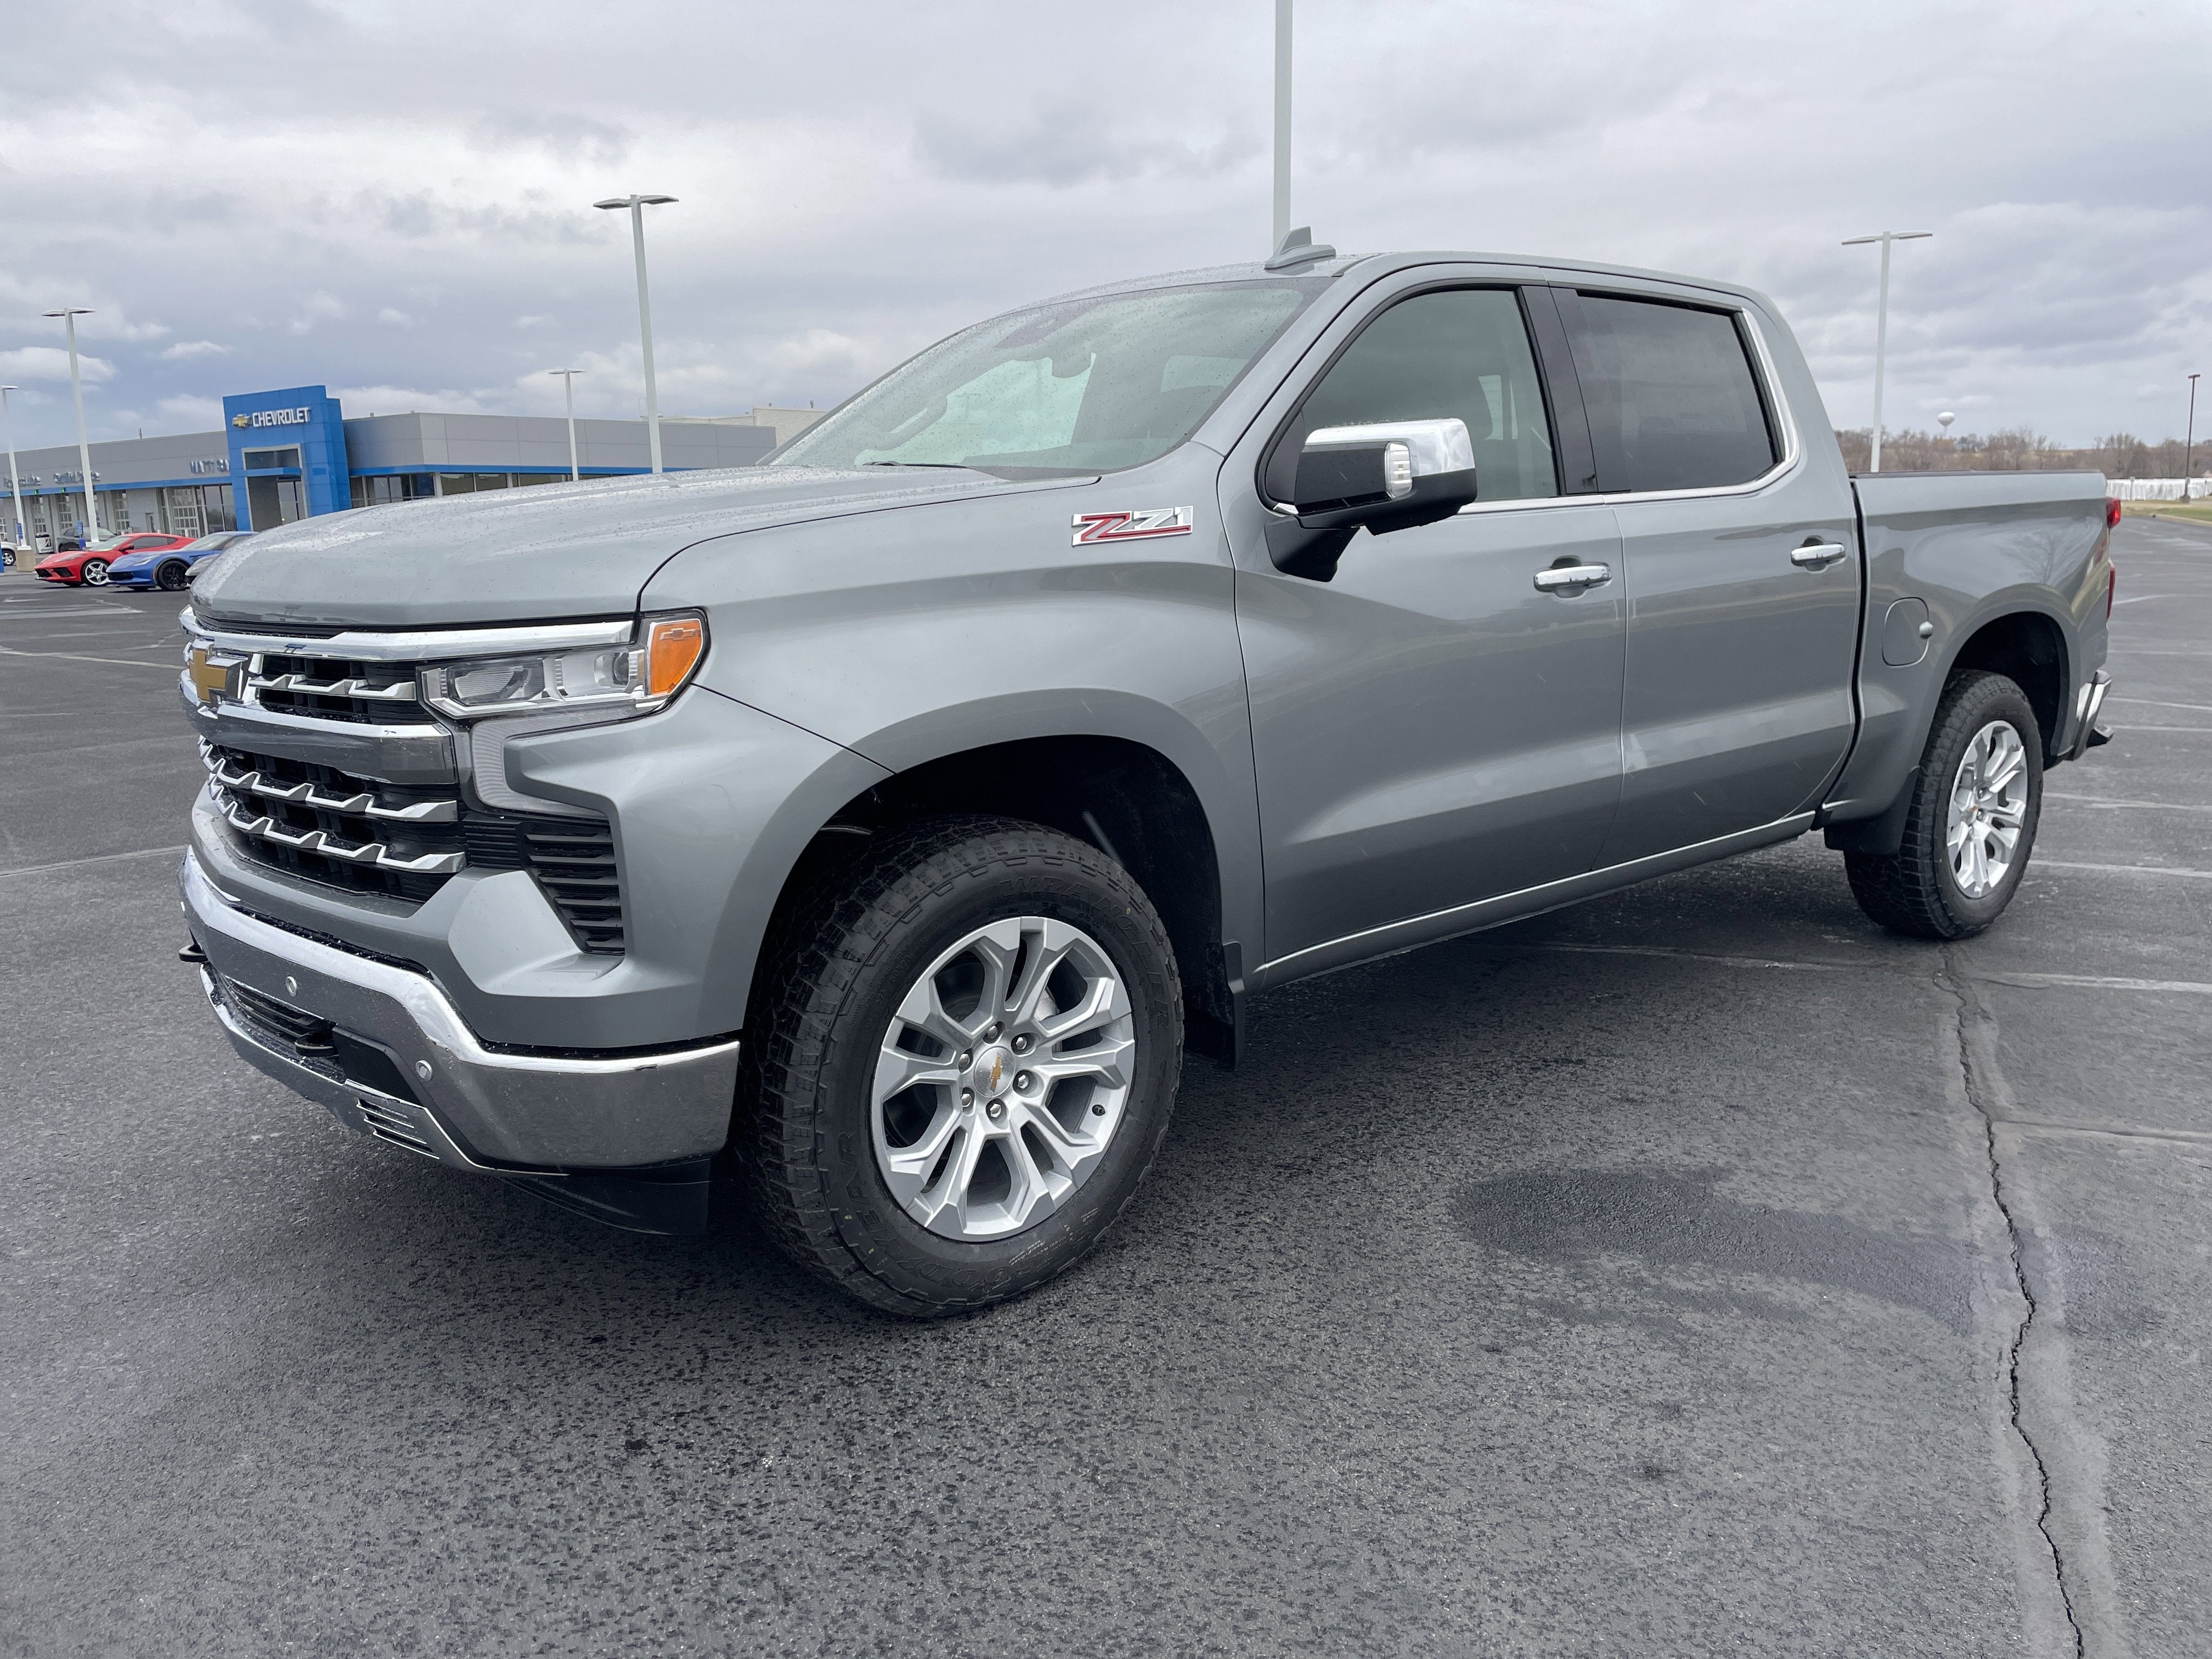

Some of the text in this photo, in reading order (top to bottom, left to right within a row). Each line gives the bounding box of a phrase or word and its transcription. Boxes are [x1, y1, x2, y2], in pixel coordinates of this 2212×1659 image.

[252, 407, 309, 427] CHEVROLET
[1071, 505, 1193, 548] Z71
[999, 876, 1170, 1028] WRANGLER
[838, 1131, 1049, 1287] GOODYEAR
